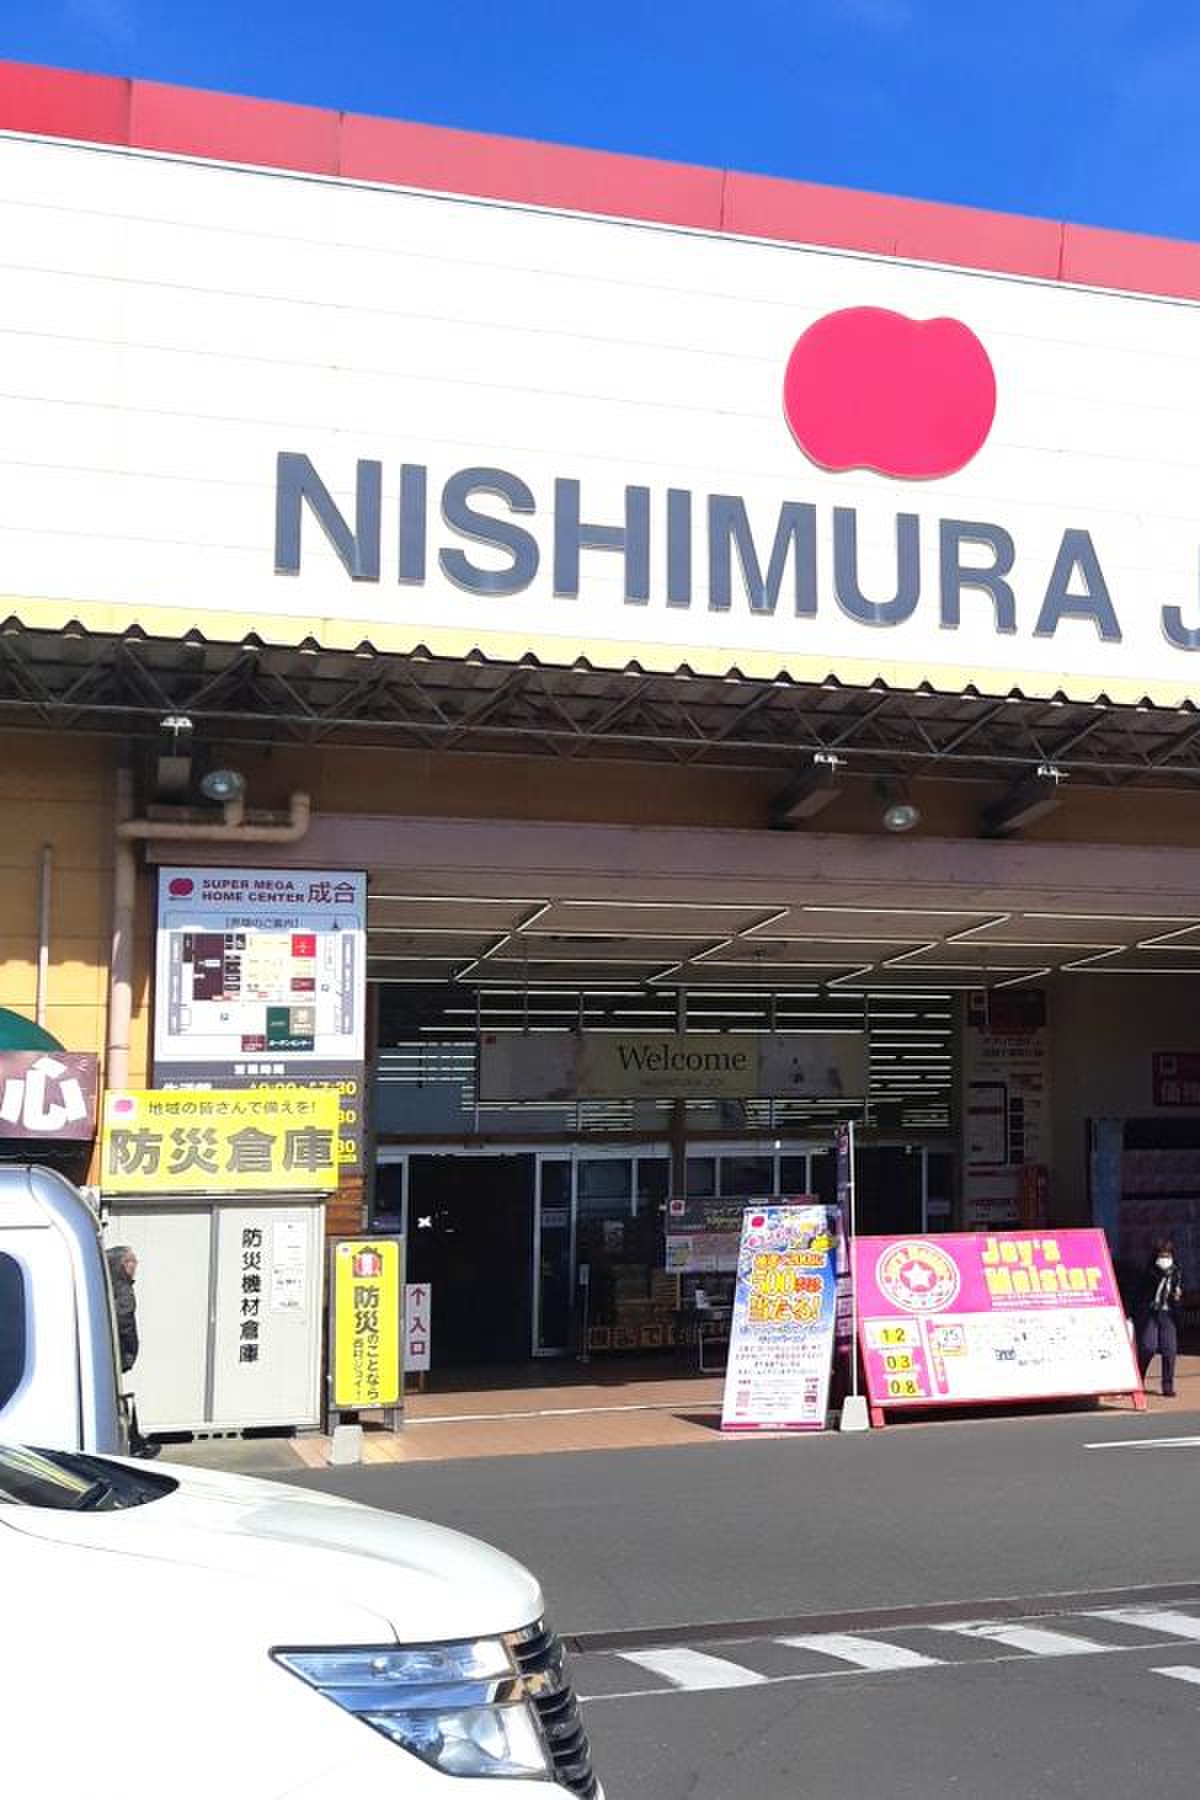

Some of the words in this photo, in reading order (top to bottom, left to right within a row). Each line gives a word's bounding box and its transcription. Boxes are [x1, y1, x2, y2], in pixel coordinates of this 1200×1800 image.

[274, 449, 1122, 642] NISHIMURA
[202, 878, 249, 889] SUPER
[202, 891, 243, 901] HOME
[248, 891, 305, 903] CENTER
[307, 881, 356, 905] 成合
[617, 1045, 748, 1072] Welcome
[0, 1056, 88, 1131] 心
[149, 1101, 317, 1115] 地域の皆さんで備えを!
[108, 1126, 335, 1174] 防災倉庫
[981, 1238, 1061, 1265] Joy's
[240, 1227, 262, 1362] 防災機材倉庫
[353, 1285, 382, 1400] 防災のことなら
[410, 1316, 427, 1356] 入口
[883, 1327, 906, 1343] 12
[886, 1353, 912, 1370] 03
[890, 1379, 917, 1395] 08
